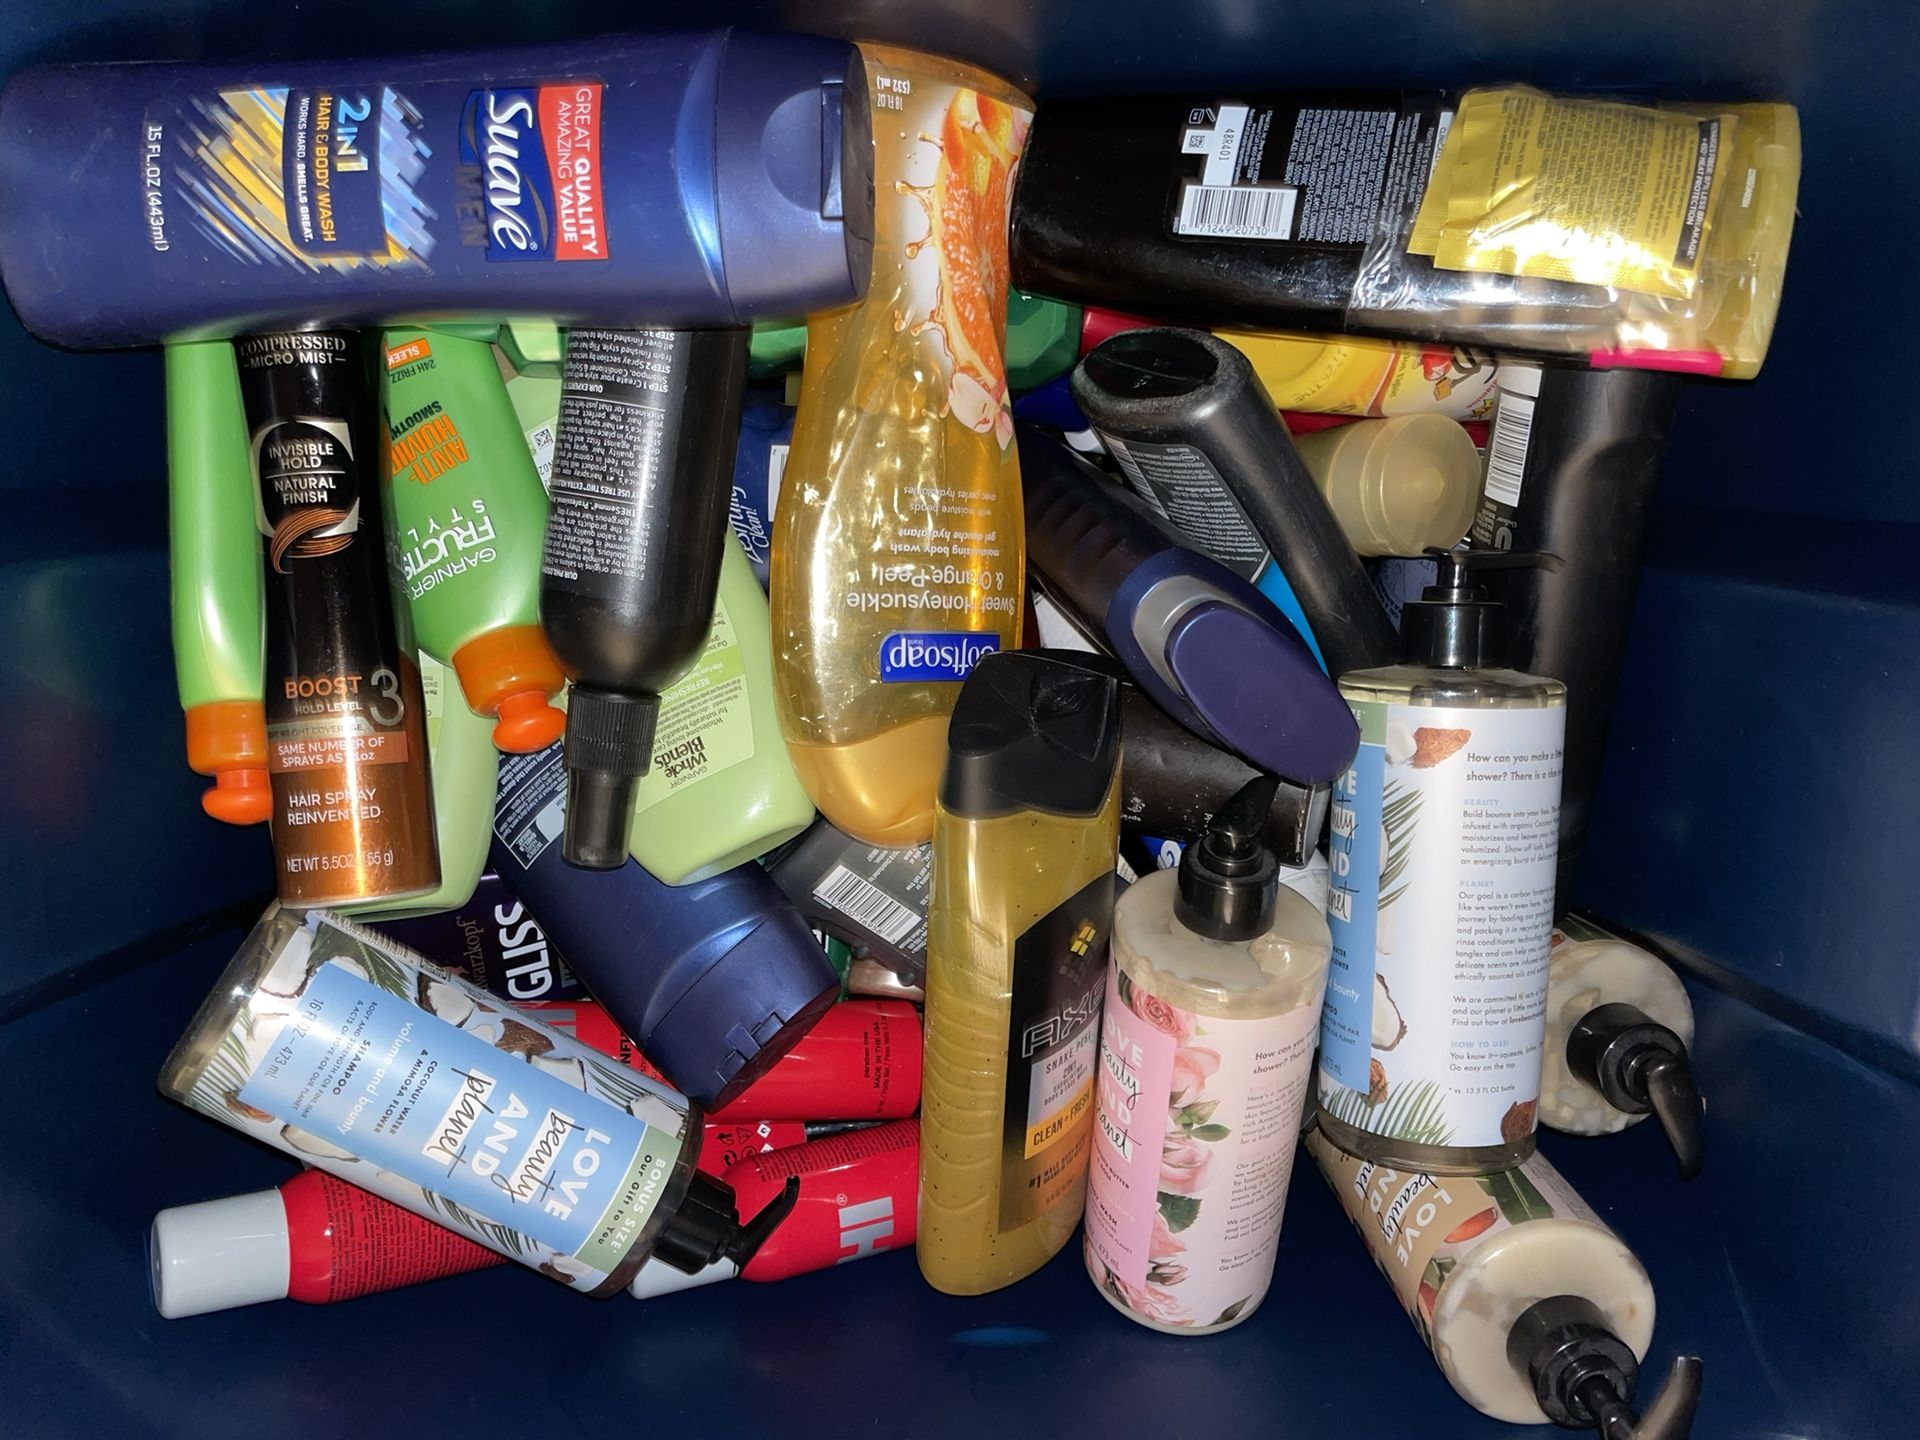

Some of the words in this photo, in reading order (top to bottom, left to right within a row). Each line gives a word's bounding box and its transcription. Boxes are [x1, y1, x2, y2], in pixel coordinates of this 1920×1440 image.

[297, 97, 310, 129] WORKS
[315, 96, 333, 130] HAIR
[572, 87, 594, 151] GREAT
[147, 126, 162, 146] 15
[555, 101, 572, 178] AMAZING
[295, 132, 306, 160] HARD.
[315, 146, 329, 188] BODY
[485, 93, 537, 251] Suave
[296, 163, 308, 203] SMELLS
[559, 184, 577, 242] VALUE
[574, 157, 597, 255] QUALITY
[149, 193, 169, 252] (443ml)
[300, 206, 313, 242] GREAT.
[317, 192, 335, 241] WASH
[250, 353, 293, 368] MICRO
[300, 353, 333, 365] MIST
[596, 354, 621, 365] section
[620, 345, 651, 359] finished
[622, 355, 644, 368] Spray
[391, 365, 416, 384] FRIZZ
[421, 359, 436, 373] 24H
[651, 362, 671, 373] STEP
[616, 376, 642, 388] Create
[585, 436, 600, 446] frizz
[602, 438, 630, 450] against
[269, 443, 334, 459] INVISIBLE
[281, 457, 321, 470] HOLD
[581, 461, 607, 472] product
[608, 466, 624, 476] This
[573, 469, 602, 480] hairspray
[275, 477, 336, 492] NATURAL
[283, 492, 328, 505] FINISH
[576, 518, 607, 531] products
[581, 512, 594, 520] hair
[594, 513, 629, 525] gorgeous
[596, 531, 616, 541] salon
[889, 542, 920, 553] wash
[923, 543, 949, 555] body
[581, 553, 604, 564] simple
[584, 562, 609, 573] origins
[609, 567, 622, 575] our
[877, 566, 925, 587] Peel
[931, 563, 992, 589] Orange
[994, 570, 1003, 589] &
[845, 586, 973, 615] Honeysuckle
[978, 595, 1015, 614] Sweet
[285, 676, 362, 699] BOOST
[370, 668, 405, 726] 3
[295, 705, 324, 715] HOLD
[327, 702, 363, 713] LEVEL
[685, 715, 723, 738] Wholesome
[688, 709, 717, 729] naturally
[659, 723, 689, 743] beautiful
[278, 745, 305, 755] SAME
[368, 737, 385, 748] OF
[652, 735, 705, 769] Blends
[283, 756, 324, 768] SPRAYS
[327, 753, 342, 763] AS
[663, 750, 707, 780] Whole
[1467, 753, 1490, 762] How
[1513, 753, 1528, 765] you
[1466, 771, 1507, 781] shower?
[1511, 772, 1532, 781] There
[289, 792, 320, 807] HAIR
[288, 806, 381, 825] REINVENED
[1463, 810, 1483, 818] Build
[1485, 810, 1511, 818] bounce
[1463, 822, 1490, 830] infused
[1493, 821, 1507, 830] with
[1462, 834, 1504, 842] moisturizes
[1473, 858, 1512, 867] energizing
[1477, 892, 1494, 901] goal
[1474, 926, 1503, 936] packing
[1456, 950, 1483, 959] tangles
[1455, 961, 1485, 969] delicate
[1487, 961, 1507, 969] scents
[1454, 972, 1486, 981] ethically
[1488, 971, 1514, 981] sourced
[308, 996, 324, 1012] 16
[382, 1019, 418, 1069] volume
[274, 1044, 294, 1067] 473
[1255, 1051, 1275, 1060] How
[1467, 1051, 1485, 1060] know
[330, 1036, 371, 1099] SHAMPOO
[873, 1066, 881, 1087] MADE
[1464, 1064, 1481, 1073] easy
[364, 1066, 388, 1096] and
[395, 1057, 423, 1099] MIMOSA
[407, 1057, 438, 1106] COCONUT
[334, 1091, 373, 1140] bounty
[372, 1097, 398, 1136] FLOWER
[388, 1104, 411, 1137] WATER
[425, 1067, 494, 1178] planet
[466, 1090, 533, 1183] AND
[1033, 1116, 1063, 1145] CLEAN
[501, 1111, 585, 1204] beauty
[635, 1153, 653, 1177] Our
[542, 1125, 612, 1224] LOVE
[621, 1180, 641, 1206] Gift
[629, 1157, 670, 1214] BONUS
[612, 1208, 624, 1222] to
[596, 1224, 615, 1246] You
[1397, 1188, 1452, 1268] LOVE
